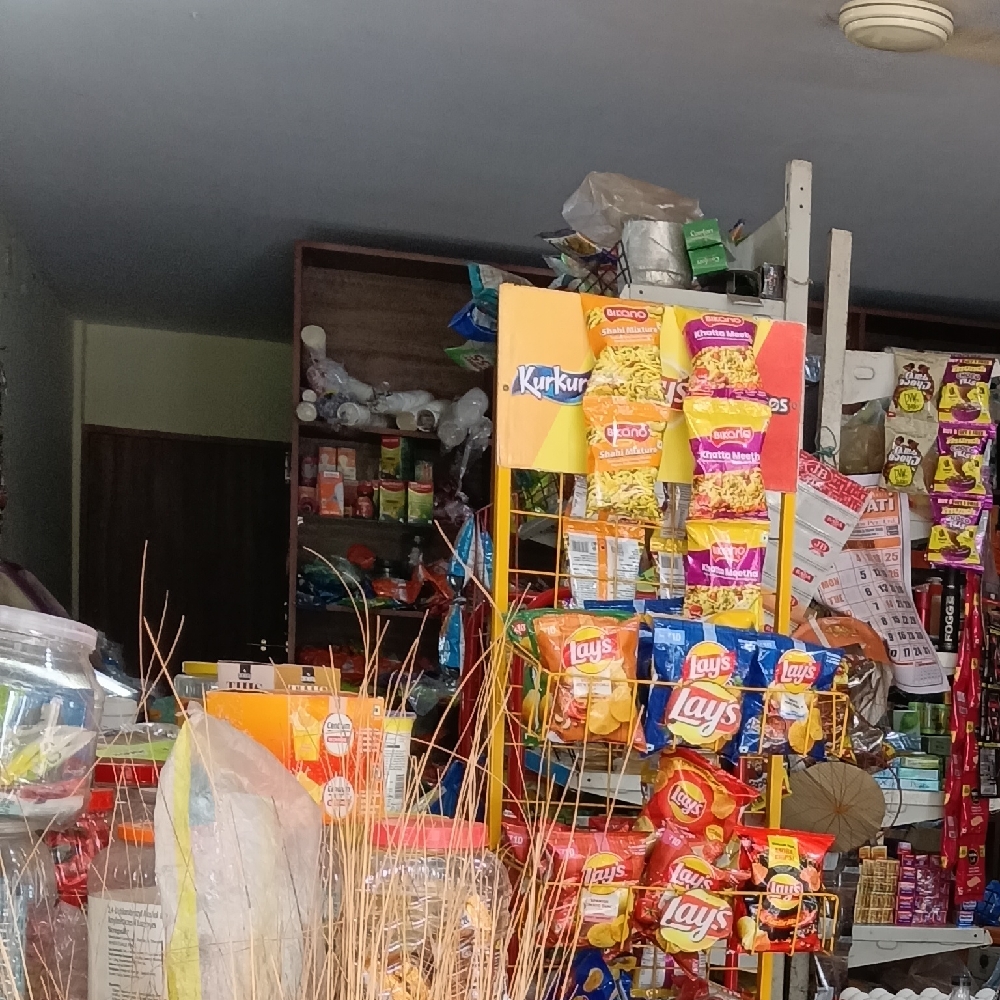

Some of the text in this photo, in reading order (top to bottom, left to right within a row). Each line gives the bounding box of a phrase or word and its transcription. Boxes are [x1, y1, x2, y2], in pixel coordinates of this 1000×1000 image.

[884, 552, 899, 562] 25
[820, 577, 840, 590] MON
[859, 570, 867, 580] 5
[569, 636, 613, 665] Lay's
[689, 652, 731, 679] Lay's
[781, 659, 816, 684] Lay's
